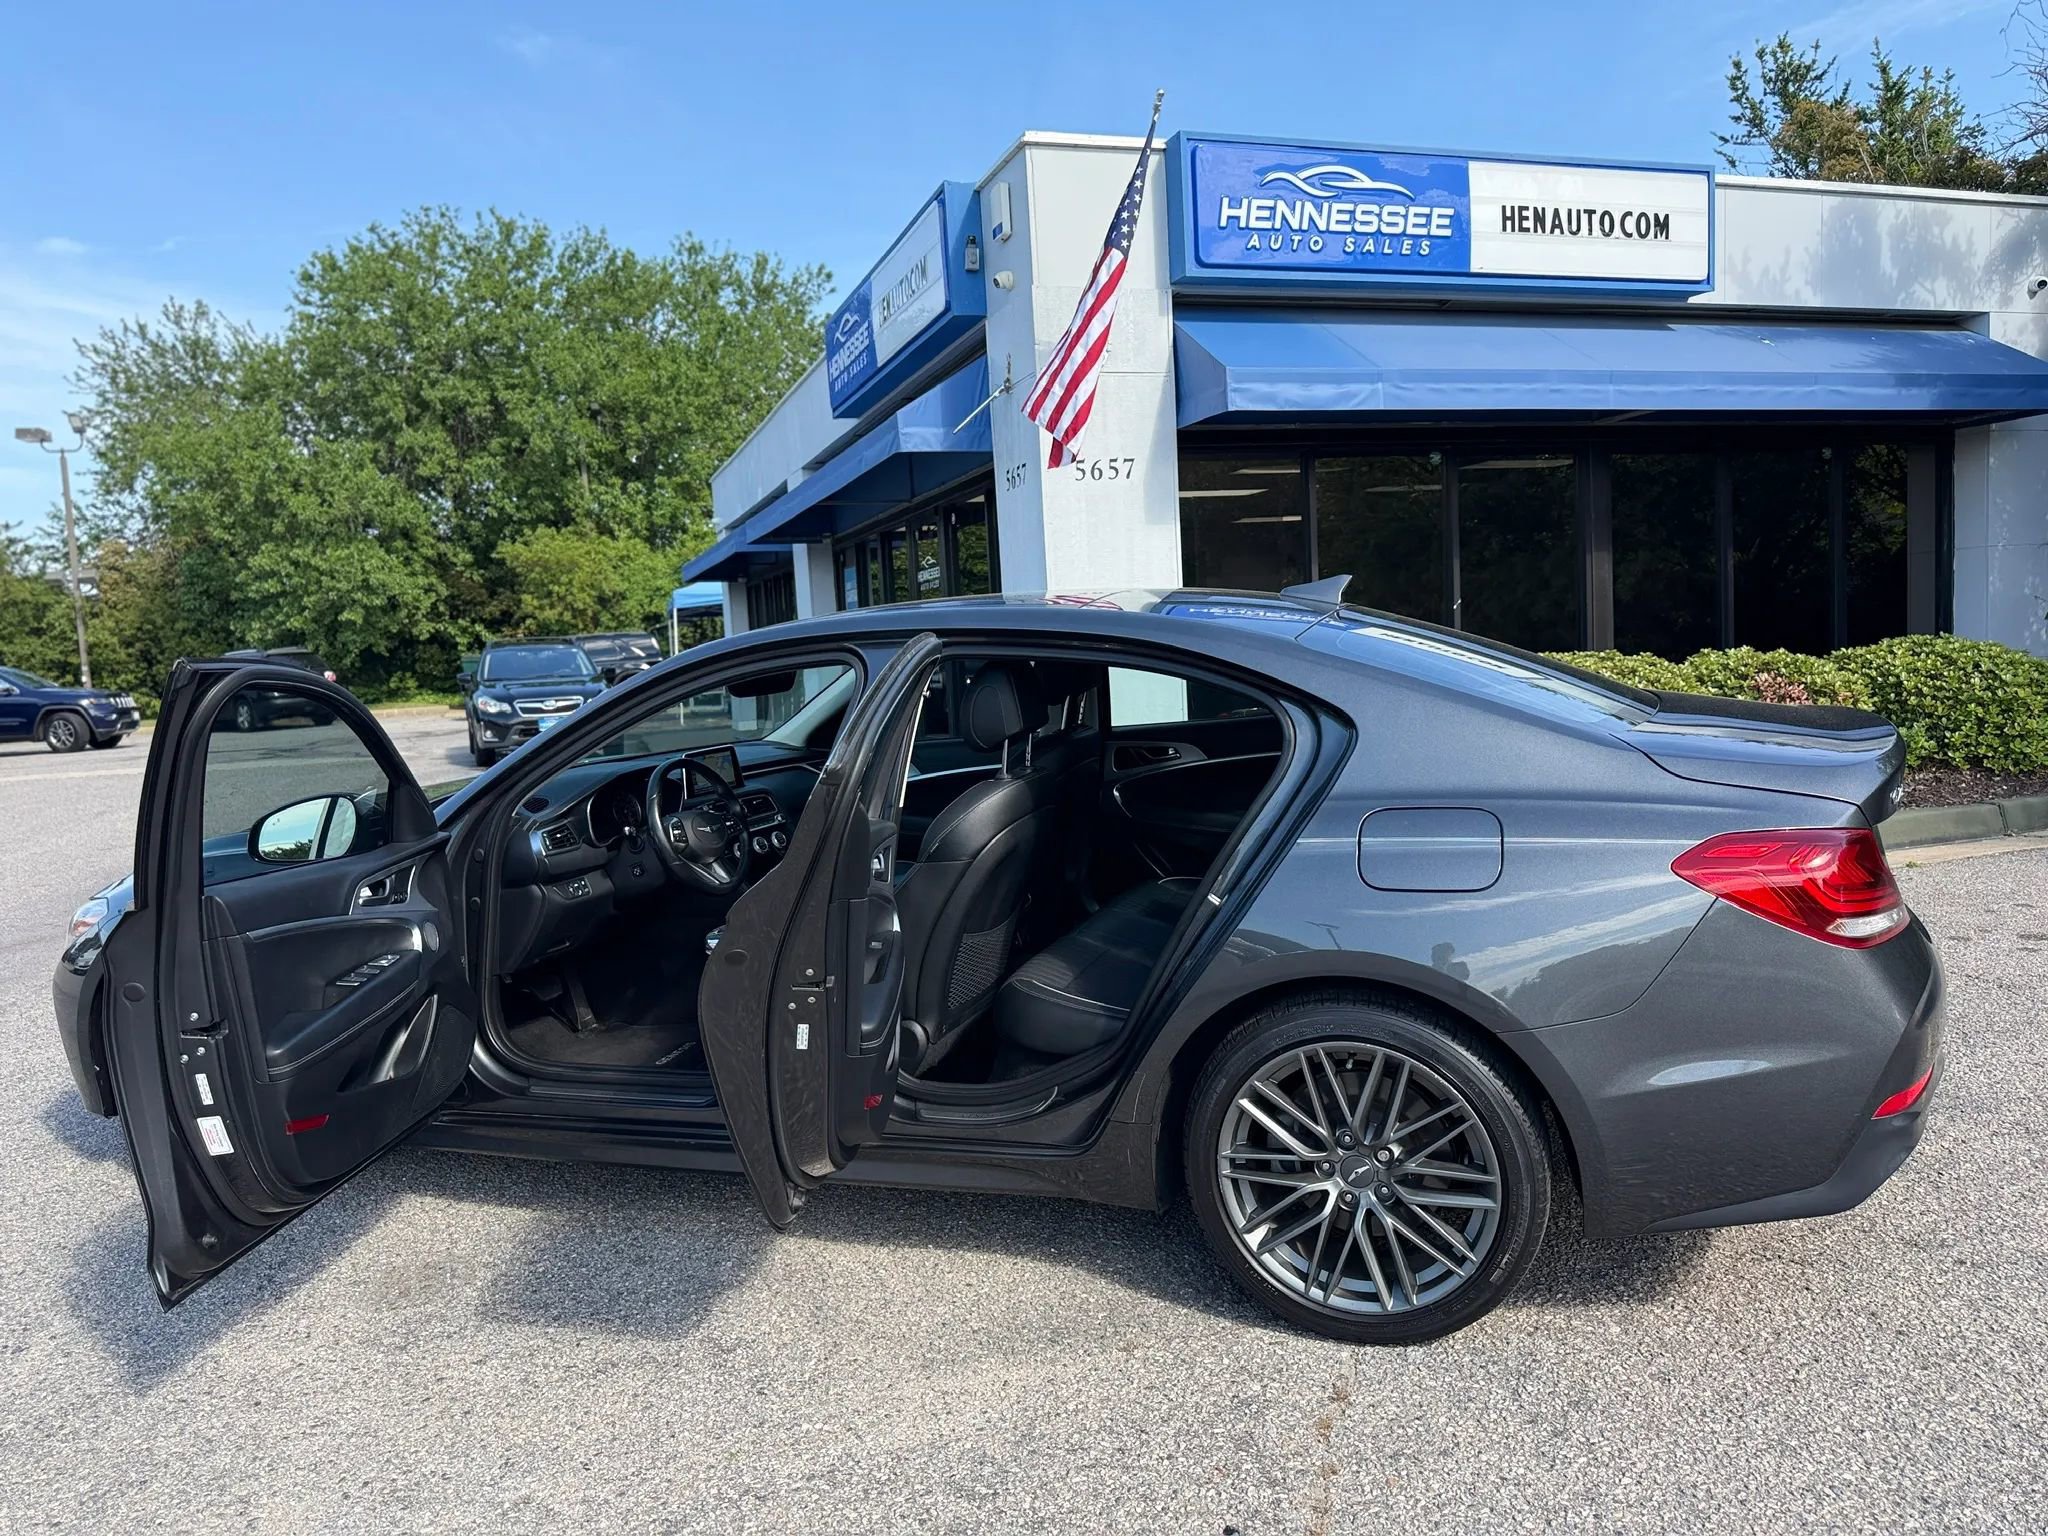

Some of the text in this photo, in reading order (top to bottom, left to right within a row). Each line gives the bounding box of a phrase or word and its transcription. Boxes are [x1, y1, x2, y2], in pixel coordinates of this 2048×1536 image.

[1219, 195, 1455, 237] HENNESSEE
[1247, 232, 1431, 256] AUTO SALES
[828, 320, 870, 383] HENNESSEE
[849, 350, 867, 378] SALES
[1006, 462, 1027, 492] 5657
[1075, 457, 1136, 481] 5657
